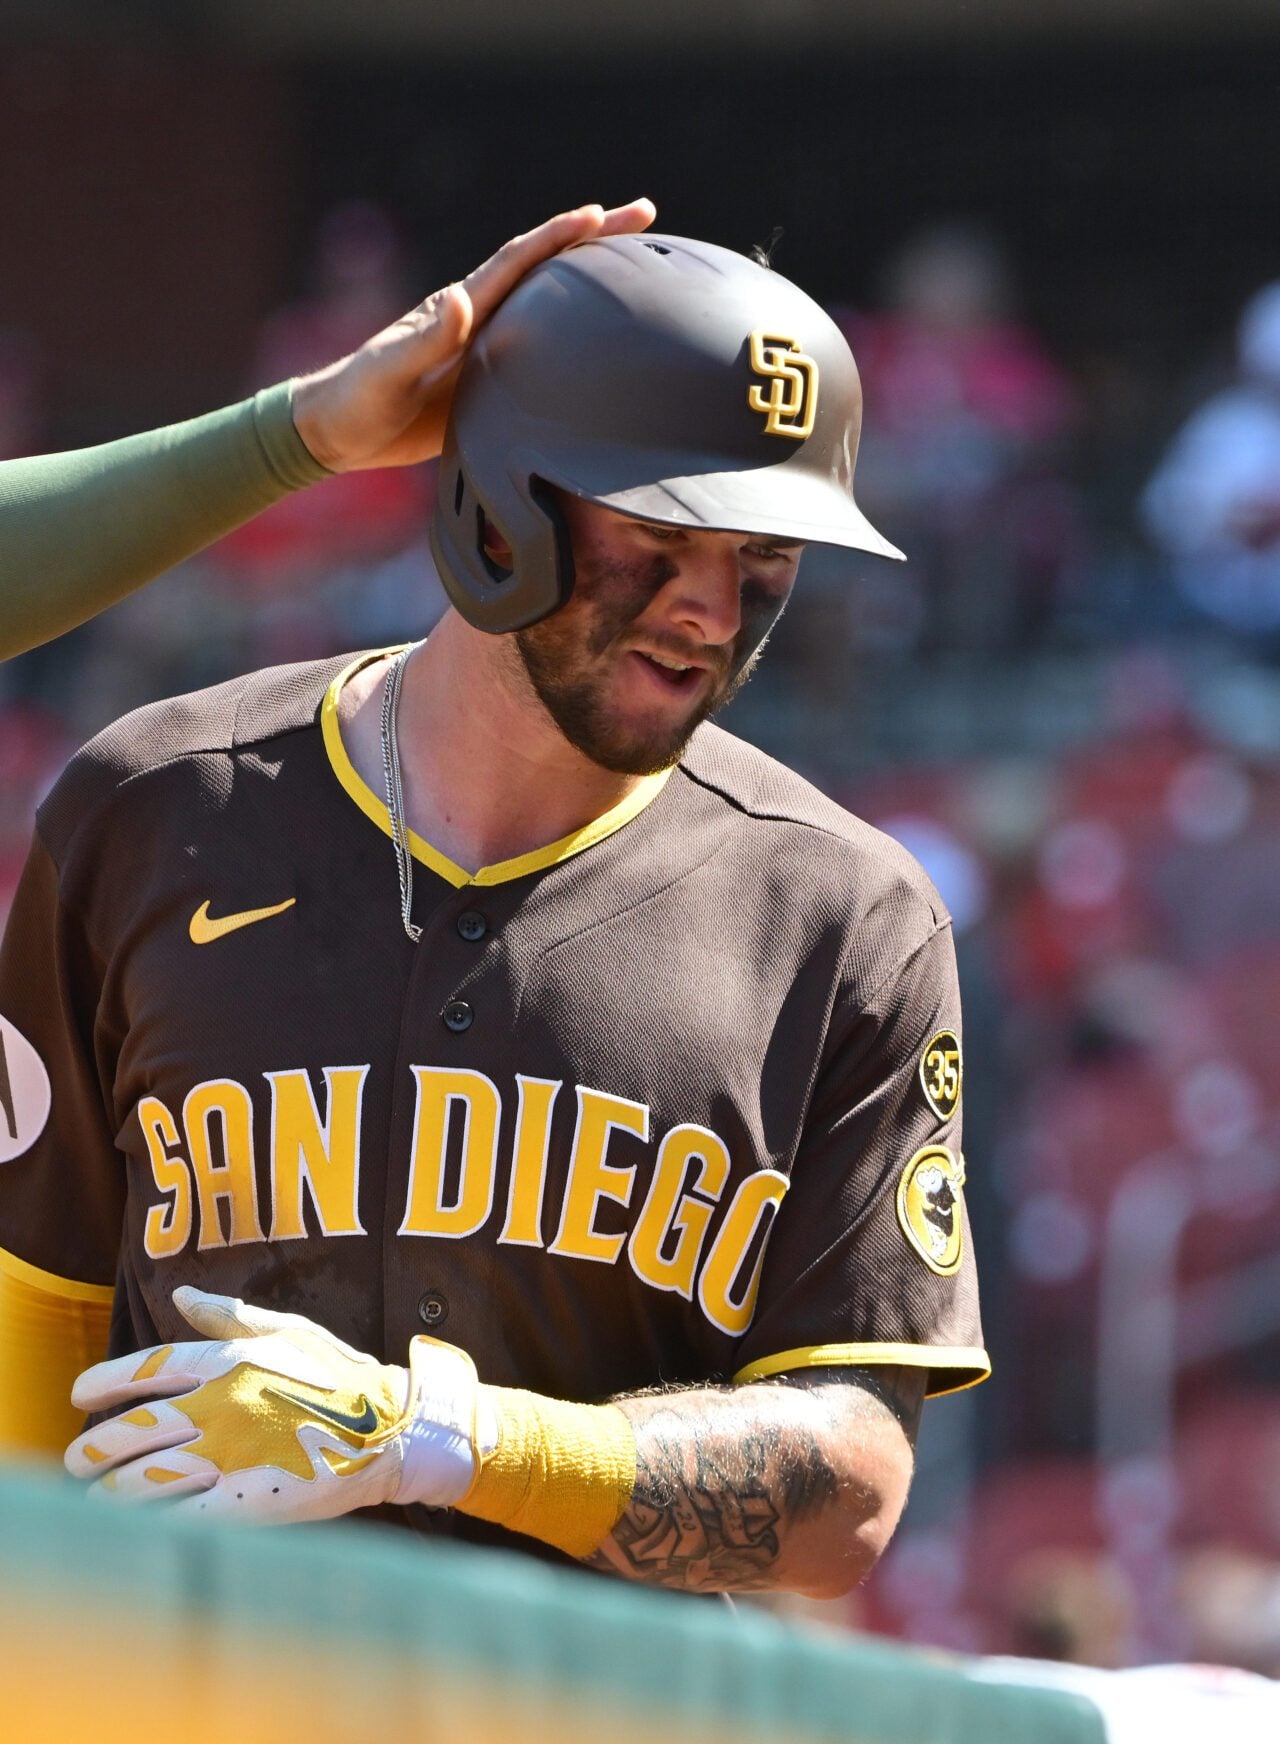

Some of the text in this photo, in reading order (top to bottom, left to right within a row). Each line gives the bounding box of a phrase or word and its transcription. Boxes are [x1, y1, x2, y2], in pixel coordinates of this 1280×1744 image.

[747, 330, 819, 440] SD
[926, 1050, 959, 1101] 35
[137, 1063, 791, 1338] SAN DIEGO
